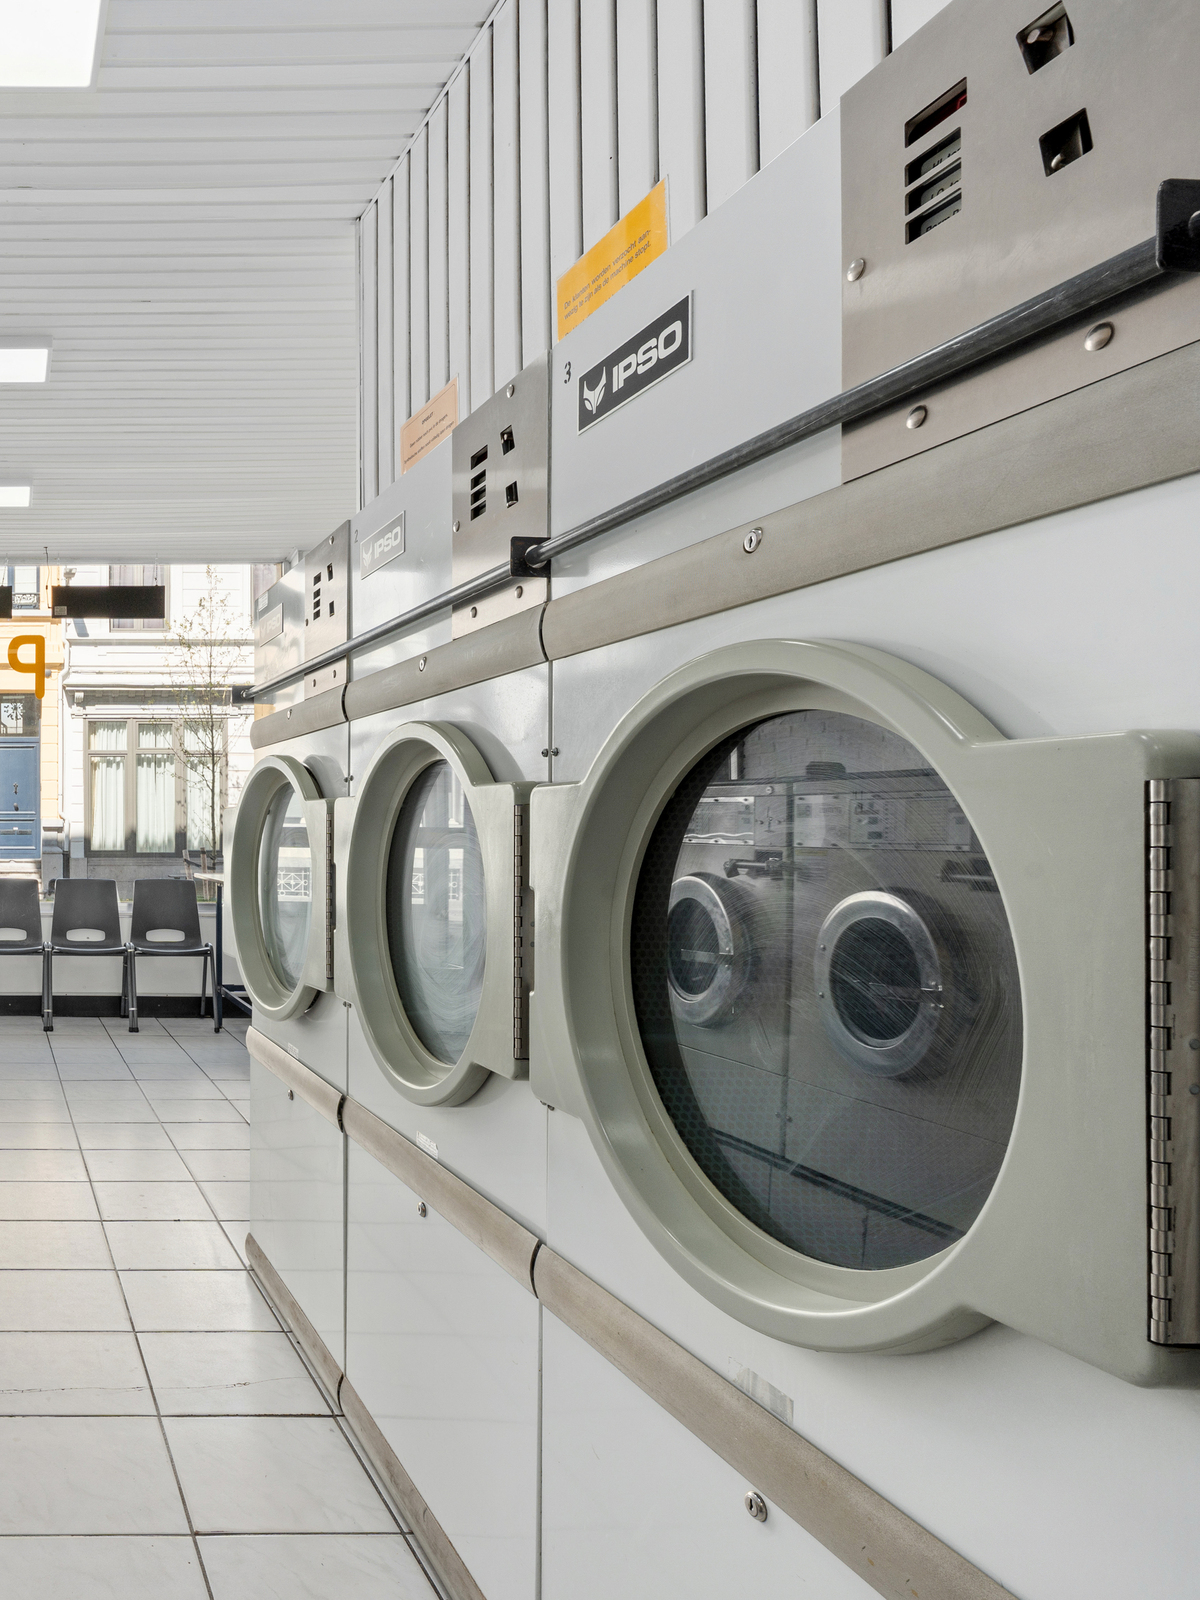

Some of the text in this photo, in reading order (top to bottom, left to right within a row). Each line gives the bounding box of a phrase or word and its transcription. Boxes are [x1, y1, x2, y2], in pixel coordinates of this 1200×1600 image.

[563, 301, 571, 310] De
[572, 283, 590, 301] klanten
[591, 264, 611, 285] worden
[612, 241, 636, 266] verzocht
[584, 290, 594, 303] zijn
[594, 284, 602, 294] als
[602, 277, 609, 286] de
[610, 256, 633, 281] machine
[563, 361, 572, 384] 3
[612, 320, 682, 393] IPSO
[354, 529, 358, 544] 2
[374, 526, 401, 559] IPSO
